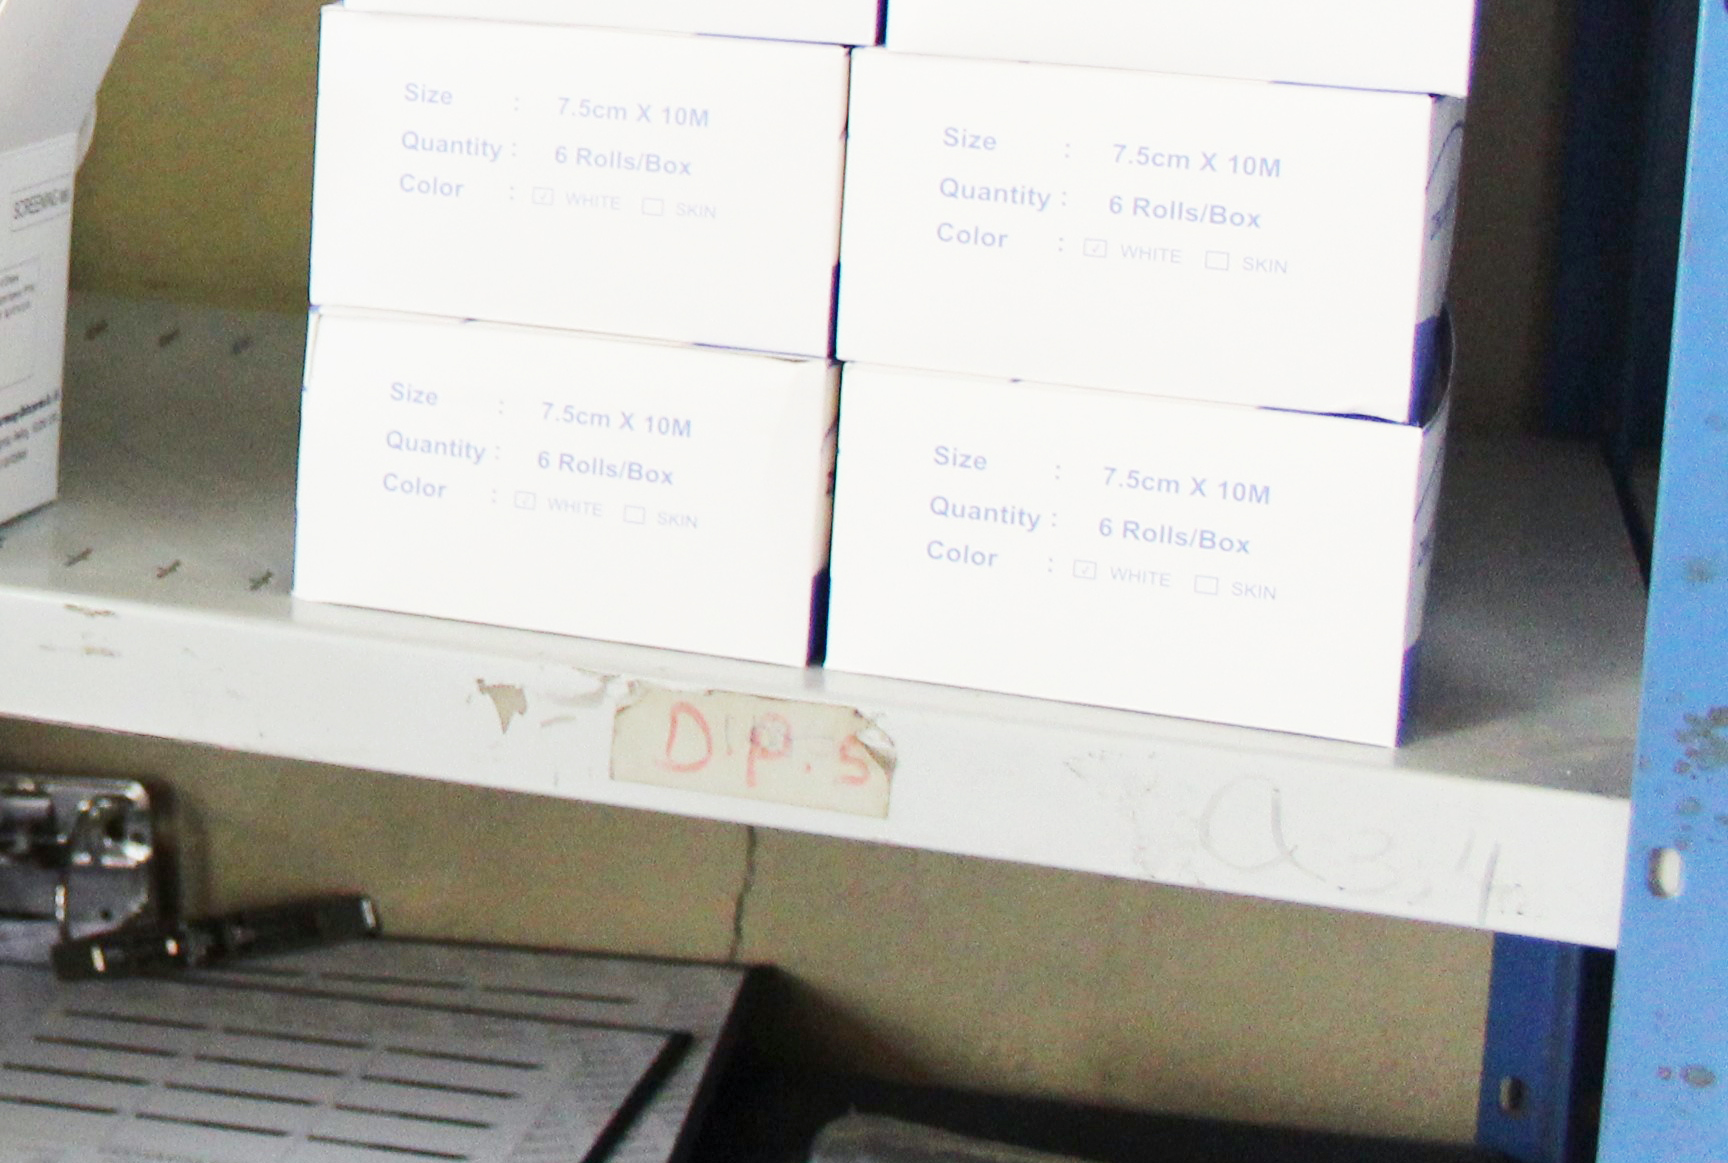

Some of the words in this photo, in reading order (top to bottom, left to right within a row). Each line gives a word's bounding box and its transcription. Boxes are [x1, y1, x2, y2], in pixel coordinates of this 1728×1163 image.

[404, 83, 453, 105] Size
[559, 97, 627, 120] 7.5cm
[637, 104, 651, 122] X
[663, 107, 709, 127] 10M
[401, 131, 502, 162] Quantity
[555, 146, 567, 164] 6
[576, 147, 691, 175] Rolls/Box
[943, 127, 997, 151] Size
[1114, 144, 1190, 169] 7.5cm
[1200, 152, 1217, 172] X
[1229, 155, 1281, 177] 10M
[399, 173, 464, 197] Color
[566, 192, 619, 210] WHITE
[676, 203, 716, 219] SKIN
[939, 177, 1051, 212] Quantity
[1109, 195, 1123, 214] 6
[1133, 197, 1260, 228] Rolls/Box
[936, 222, 1008, 248] Color
[1120, 244, 1180, 264] WHITE
[1243, 256, 1288, 274] SKIN
[390, 382, 438, 406] Size
[543, 402, 611, 428] 7.5cm
[620, 411, 634, 431] X
[646, 416, 692, 438] 10M
[386, 430, 486, 465] Quantity
[537, 451, 550, 469] 6
[559, 453, 673, 485] Rolls/Box
[934, 445, 987, 471] Size
[1104, 467, 1180, 494] 7.5cm
[1190, 477, 1206, 497] X
[1219, 481, 1270, 504] 10M
[383, 472, 447, 498] Color
[547, 497, 601, 517] WHITE
[658, 512, 698, 529] SKIN
[930, 496, 1041, 532] Quantity
[1099, 518, 1113, 537] 6
[1122, 520, 1249, 554] Rolls/Box
[927, 540, 998, 567] Color
[1110, 567, 1170, 588] WHITE
[1232, 582, 1276, 600] SKIN
